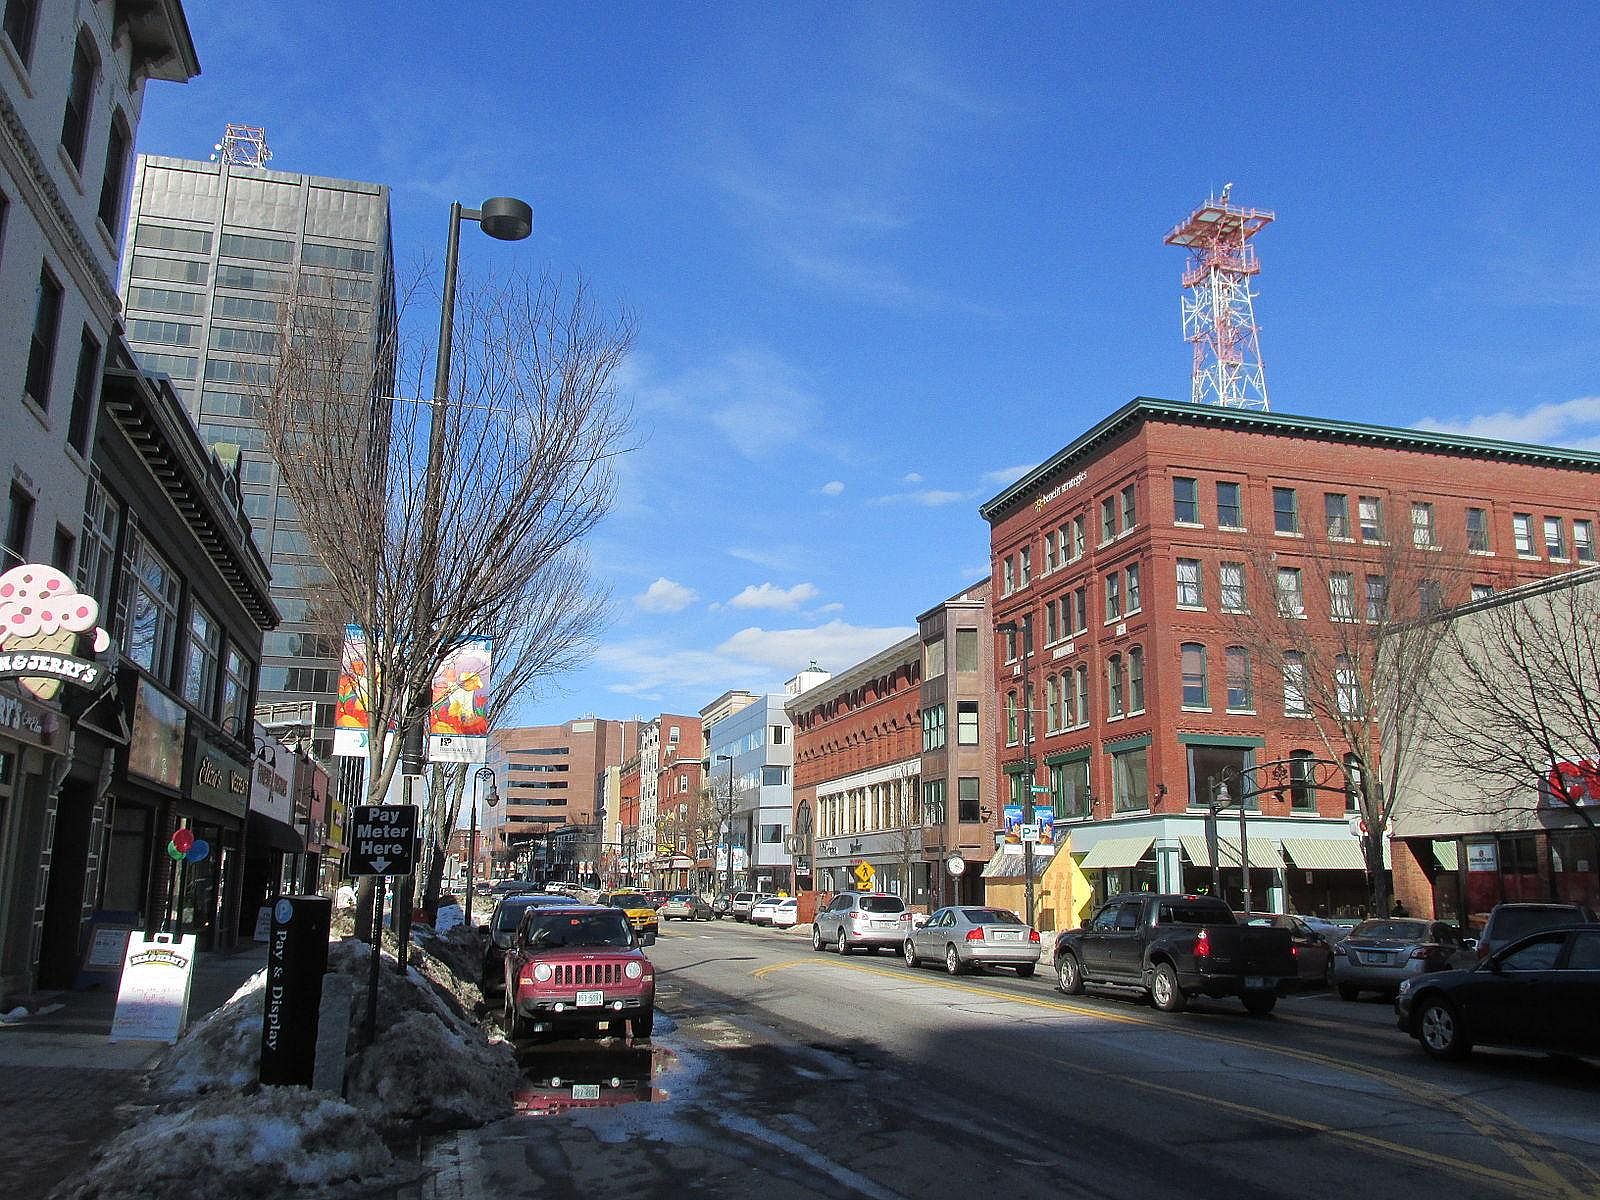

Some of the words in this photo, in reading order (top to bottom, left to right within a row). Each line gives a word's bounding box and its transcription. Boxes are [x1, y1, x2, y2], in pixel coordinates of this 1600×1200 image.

[1043, 486, 1061, 504] benefit
[1061, 471, 1088, 493] strategies
[27, 655, 98, 683] JERRY'S
[198, 756, 223, 789] Eliza's
[368, 807, 400, 824] Pay
[357, 824, 409, 838] Meter
[1022, 827, 1031, 839] P
[360, 840, 403, 855] Here
[272, 929, 288, 960] Pay
[273, 966, 284, 979] &
[266, 986, 284, 1050] Display
